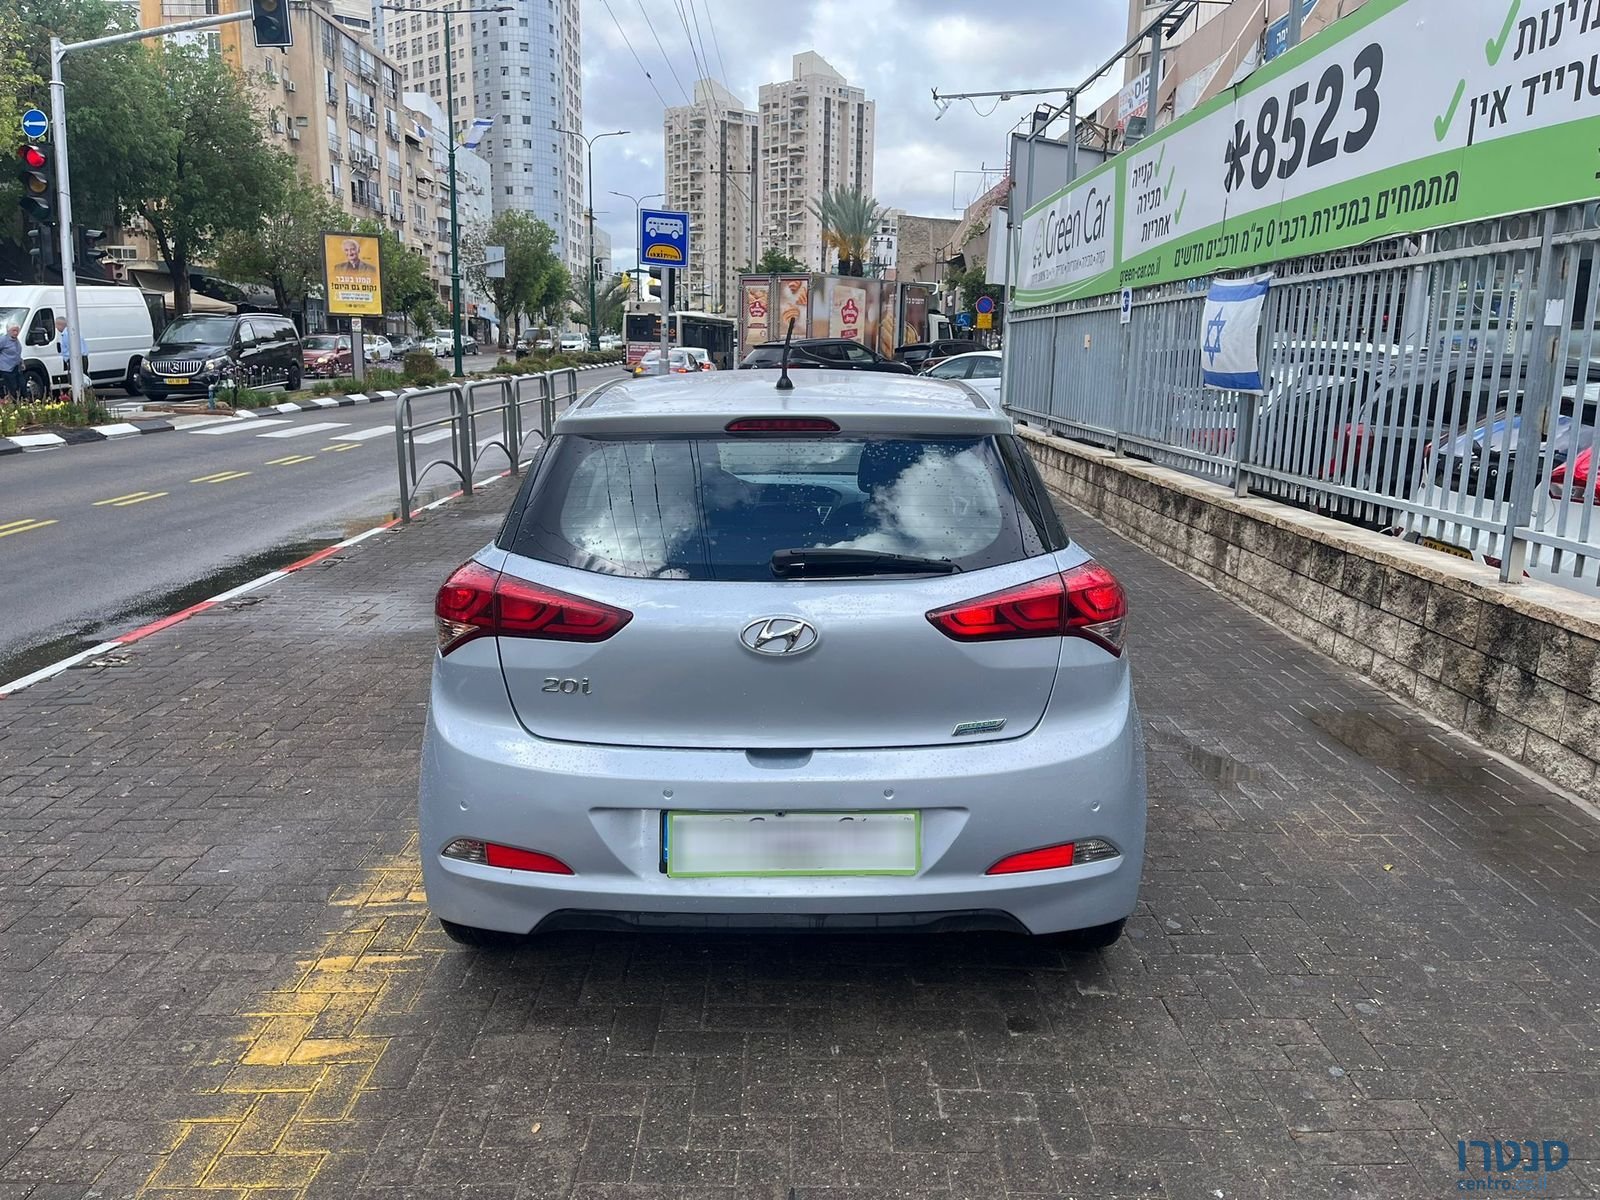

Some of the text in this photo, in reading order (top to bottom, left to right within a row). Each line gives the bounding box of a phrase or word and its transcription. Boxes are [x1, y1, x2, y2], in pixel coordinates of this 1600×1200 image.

[1467, 84, 1512, 147] אין
[1132, 161, 1154, 189] קנייה
[1137, 187, 1161, 215] מכירה
[1375, 170, 1459, 220] מתמחים
[1045, 187, 1110, 259] Green Car
[1141, 214, 1171, 242] אחריות
[1279, 215, 1307, 244] רכבי
[1309, 197, 1370, 237] במכירת
[1174, 242, 1204, 268] חדשים
[1205, 232, 1239, 261] ורכבים
[541, 677, 592, 696] 20i
